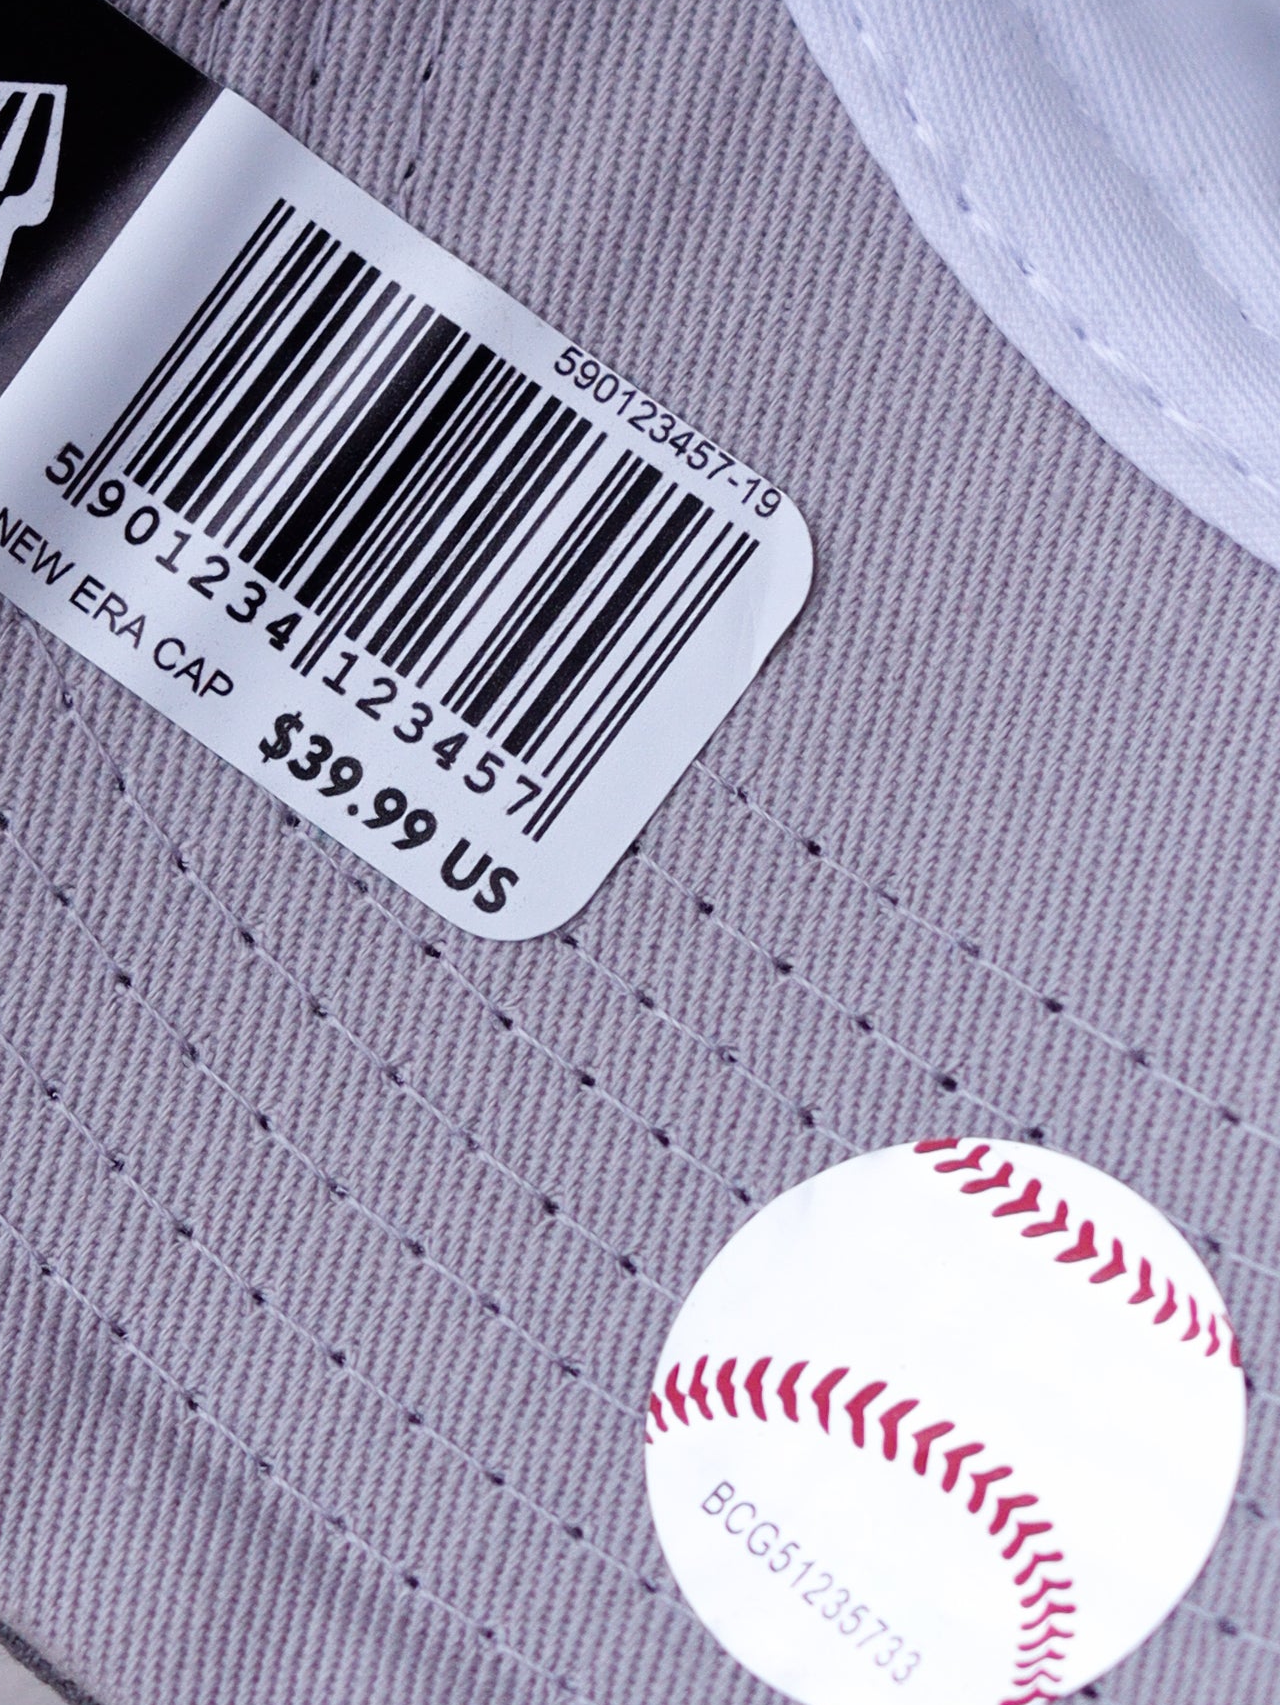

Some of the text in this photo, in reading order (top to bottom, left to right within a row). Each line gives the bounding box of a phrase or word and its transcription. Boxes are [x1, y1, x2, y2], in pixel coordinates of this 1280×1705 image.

[554, 345, 782, 518] 590123457-19
[68, 574, 147, 650] ERA
[153, 636, 235, 698] CAP
[258, 710, 521, 914] $39.99 US
[701, 1480, 922, 1686] BCG51235733
